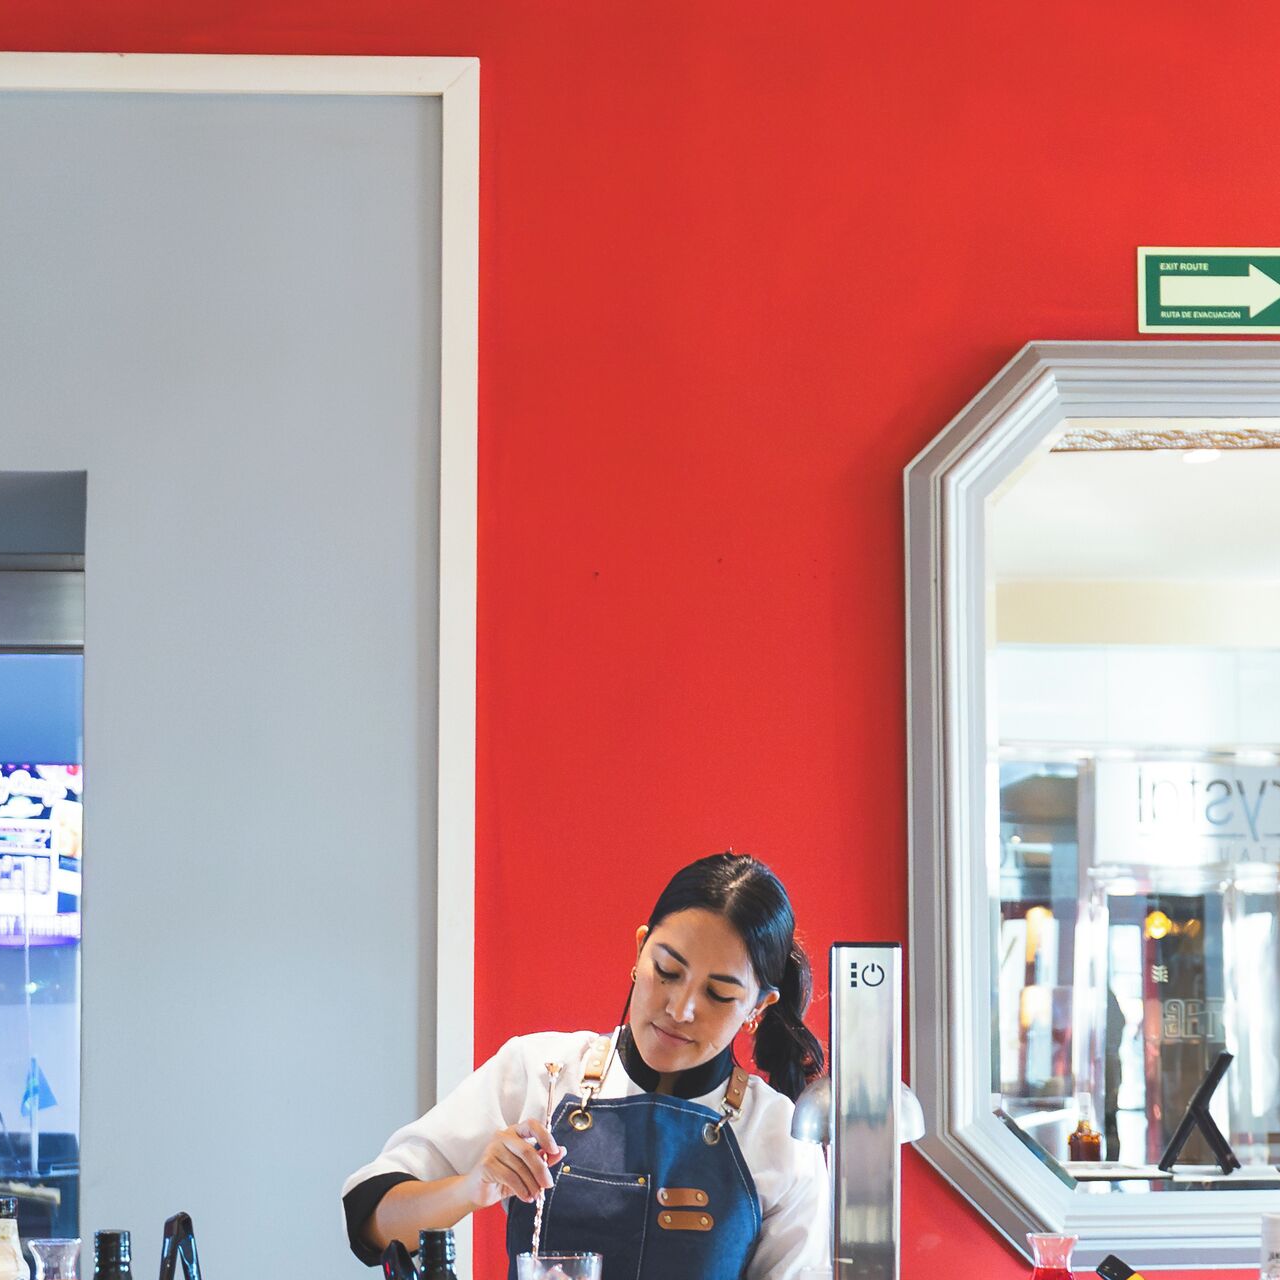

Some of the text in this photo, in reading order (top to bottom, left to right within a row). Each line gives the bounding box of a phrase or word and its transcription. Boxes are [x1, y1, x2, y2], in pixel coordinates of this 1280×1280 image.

[1160, 263, 1210, 271] EXIT ROUTE
[1161, 311, 1181, 319] RUTA
